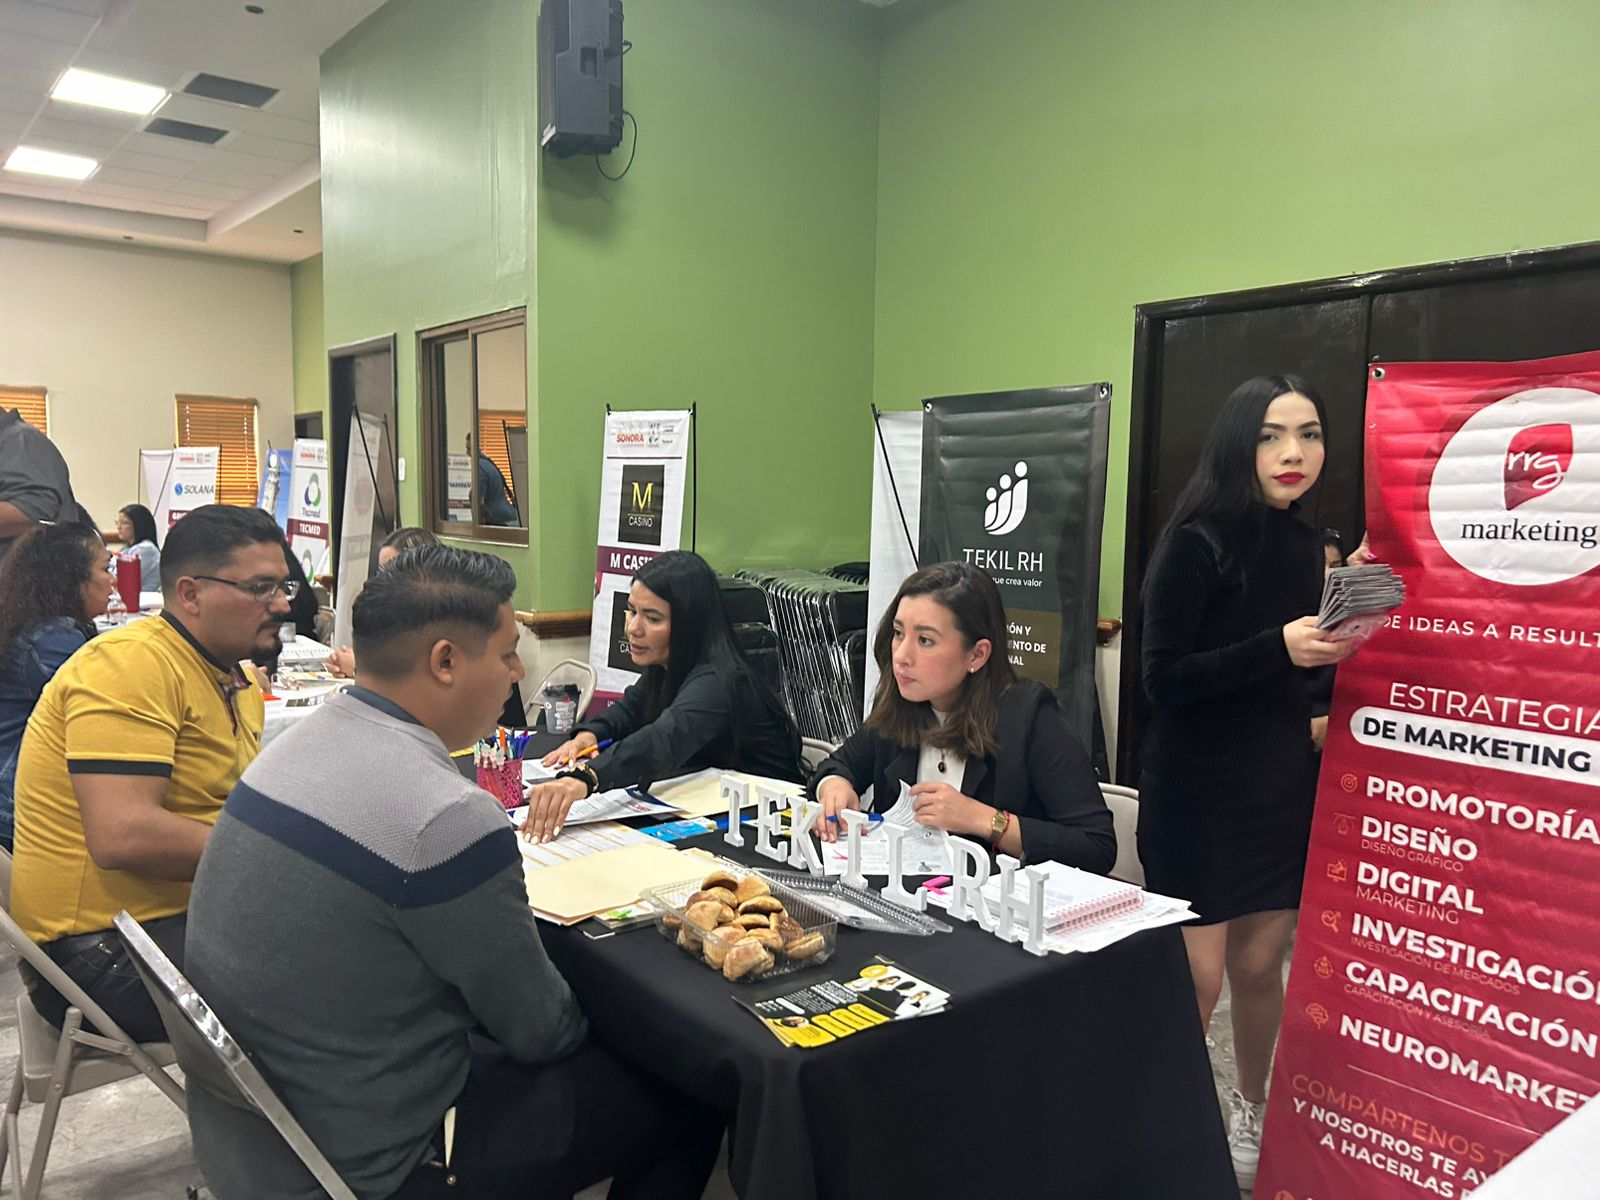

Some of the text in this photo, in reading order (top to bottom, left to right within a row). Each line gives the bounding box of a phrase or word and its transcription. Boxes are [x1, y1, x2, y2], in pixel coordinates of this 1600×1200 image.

[1507, 451, 1564, 489] rrg
[184, 484, 214, 494] SOLANA
[632, 481, 654, 514] M
[299, 523, 321, 535] TECMED
[302, 507, 321, 518] Tecmed
[628, 516, 653, 528] CASINO
[1460, 518, 1598, 549] marketing
[610, 552, 621, 569] M
[962, 548, 1043, 572] TEKIL RH
[992, 577, 1043, 588] ue crea valor
[1006, 622, 1032, 636] ÓN Y
[1408, 616, 1475, 636] IDEAS
[1482, 623, 1499, 639] A
[1033, 643, 1047, 654] DE
[1363, 716, 1592, 773] DE MARKETING
[1366, 776, 1600, 845] PROMOTORÍA
[1361, 816, 1478, 861] DISEÑO
[720, 774, 1050, 956] TEKIL RH
[1356, 884, 1460, 924] MARKETING
[1357, 861, 1484, 915] DIGITAL
[1352, 913, 1600, 1006] INVESTIGACIÓ
[1434, 961, 1450, 974] DE
[1452, 967, 1520, 996] MERCADOS
[1346, 961, 1598, 1059] CAPACITACIÓN
[1292, 1074, 1485, 1164] COMPÁRTENOS
[1293, 1098, 1306, 1113] Y
[1311, 1103, 1424, 1162] NOSOTROS
[1429, 1152, 1458, 1177] TE
[1319, 1133, 1454, 1198] A HACERLAS
